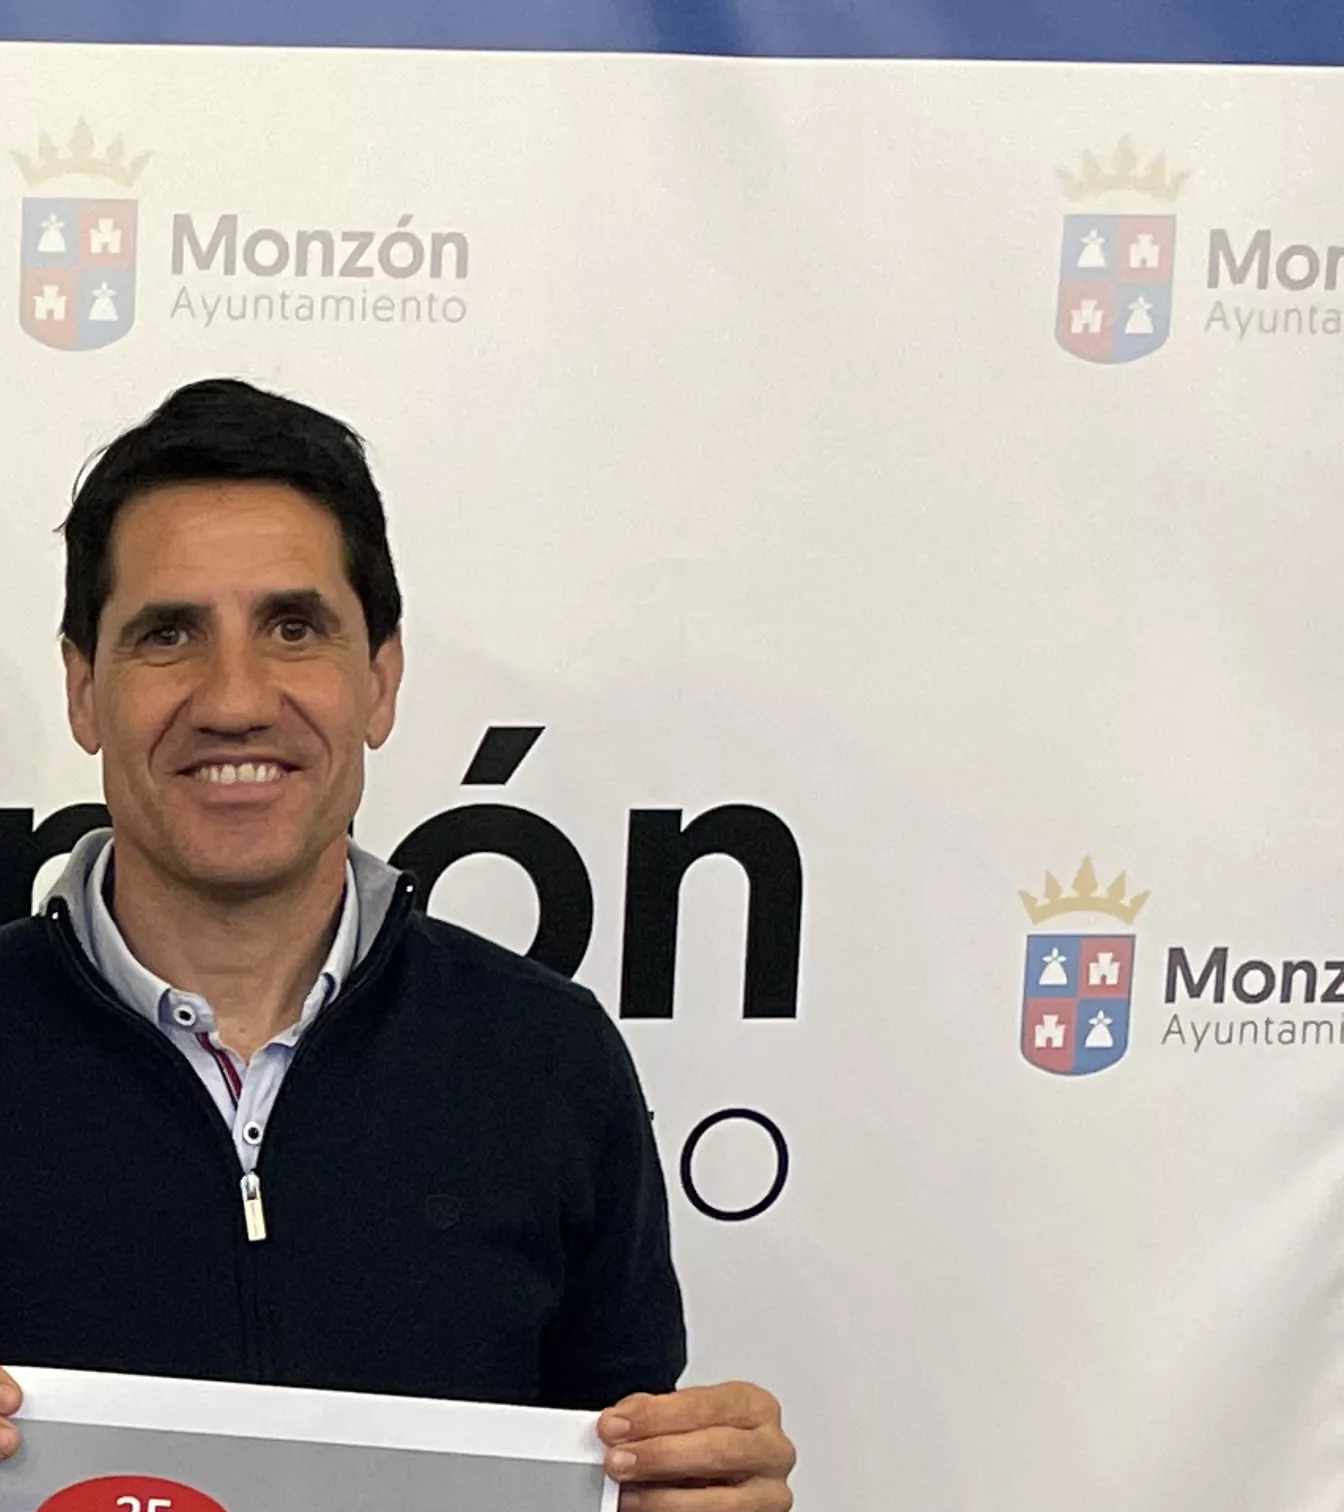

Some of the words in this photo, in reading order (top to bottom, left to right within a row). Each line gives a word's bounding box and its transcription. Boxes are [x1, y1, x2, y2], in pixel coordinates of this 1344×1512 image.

[170, 213, 468, 280] Monzón
[169, 284, 468, 327] Ayuntamiento
[1164, 946, 1344, 1004] Monz
